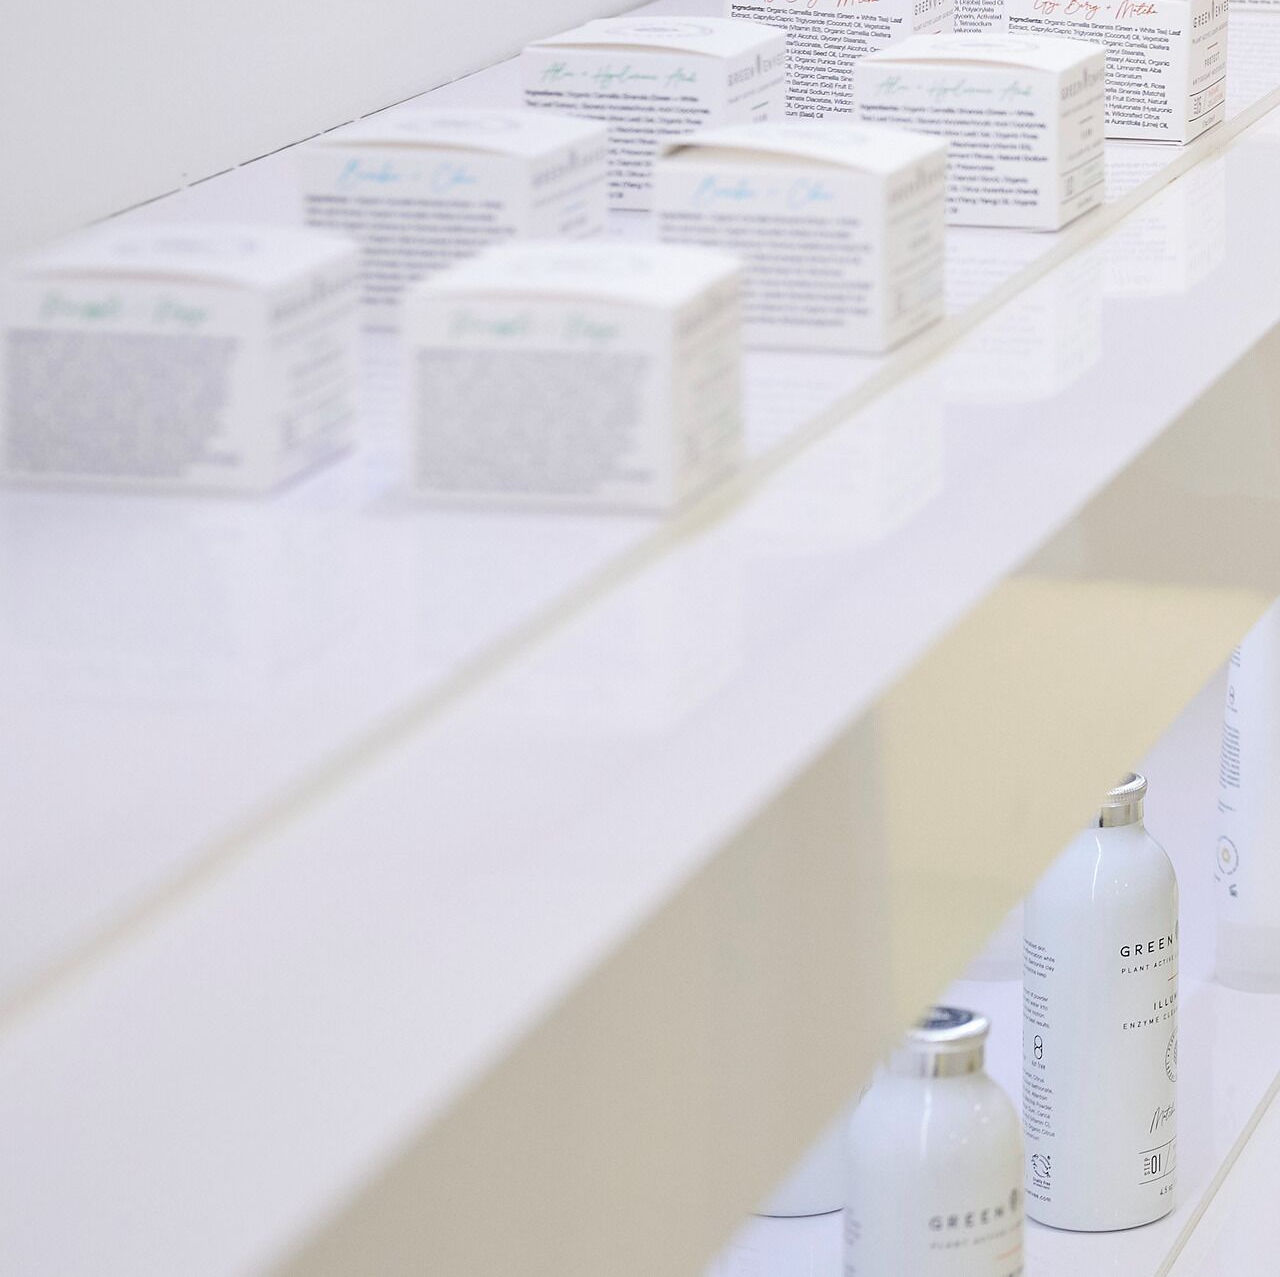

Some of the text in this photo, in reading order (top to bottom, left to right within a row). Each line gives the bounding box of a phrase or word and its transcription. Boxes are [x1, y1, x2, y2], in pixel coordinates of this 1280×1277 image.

[1120, 934, 1173, 957] GREEN
[1121, 964, 1150, 974] PLANT
[1123, 1016, 1160, 1030] ENZYME
